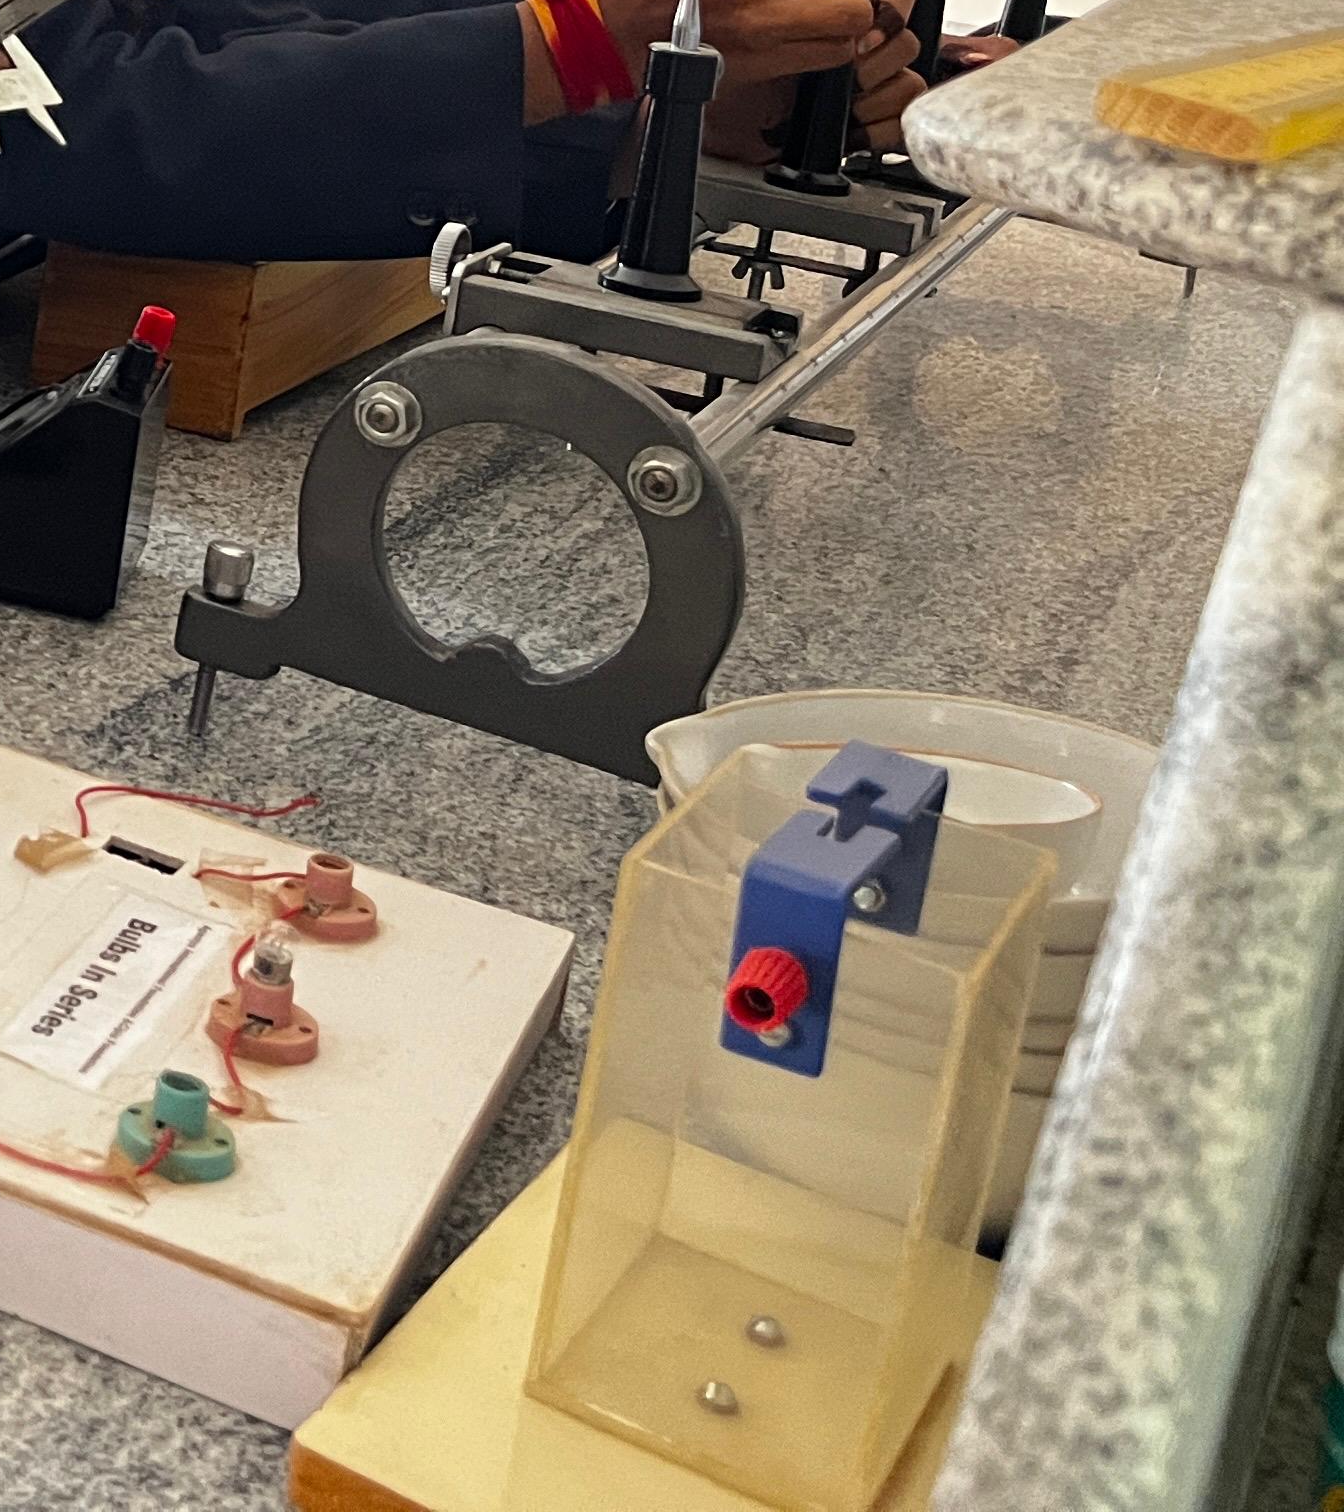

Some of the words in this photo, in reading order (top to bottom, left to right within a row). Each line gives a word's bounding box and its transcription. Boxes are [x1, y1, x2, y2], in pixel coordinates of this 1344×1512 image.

[98, 917, 159, 964] Bulbs
[79, 963, 118, 984] In
[30, 983, 99, 1038] Series
